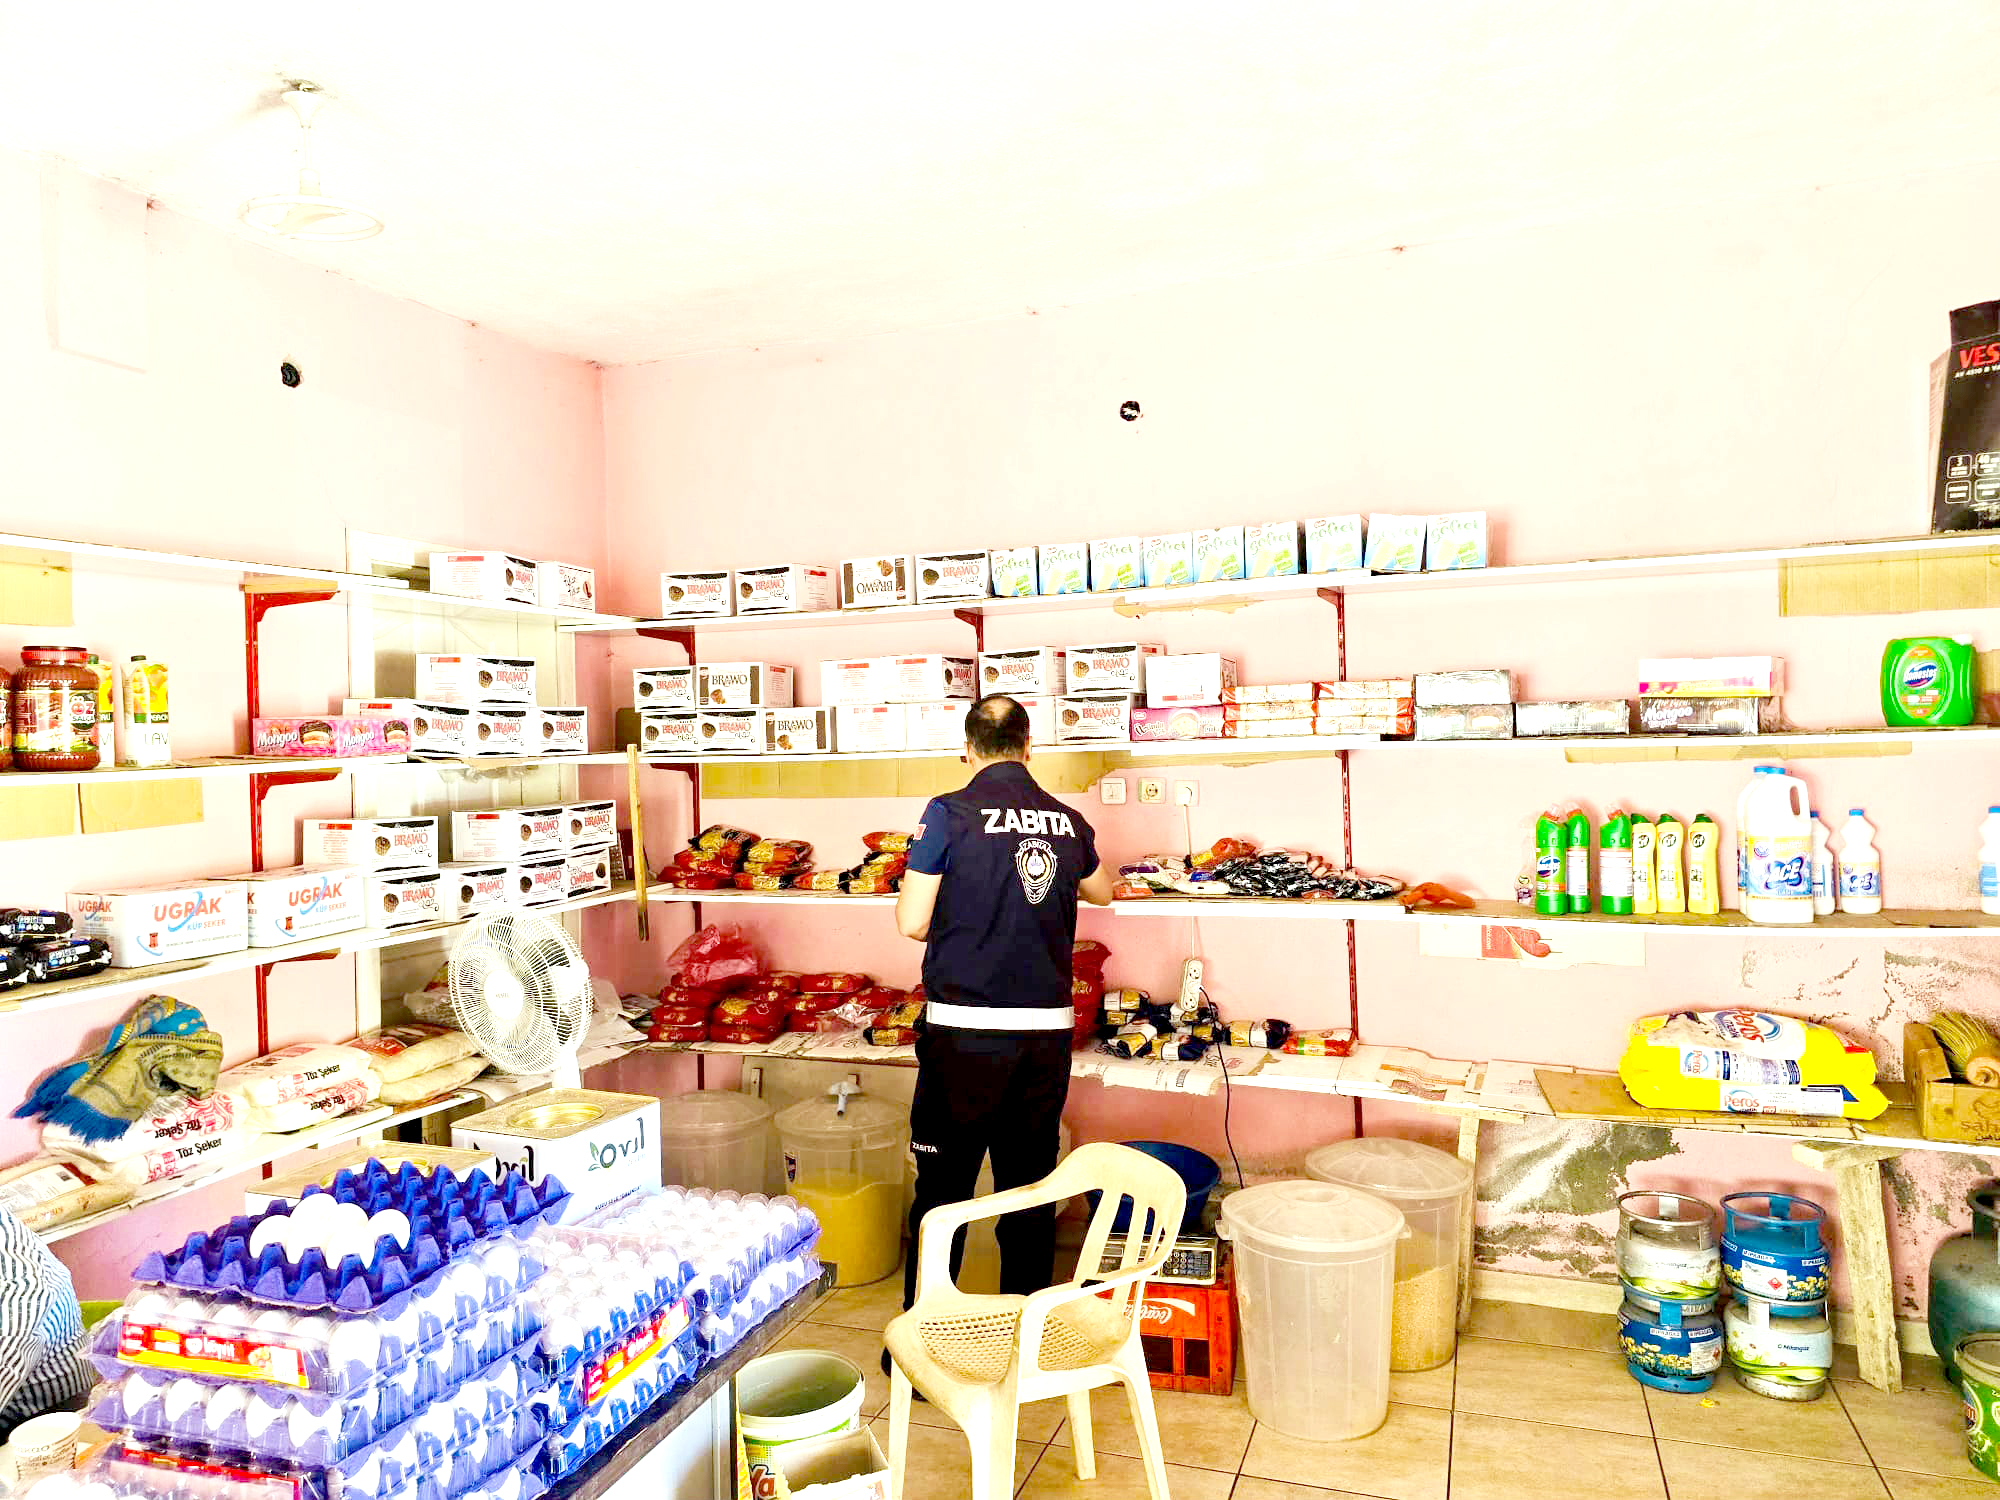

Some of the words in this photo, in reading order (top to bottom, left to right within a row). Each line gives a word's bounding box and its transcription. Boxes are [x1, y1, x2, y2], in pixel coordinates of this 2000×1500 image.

[943, 564, 979, 578] BRAWO
[687, 583, 722, 597] BRAWO
[755, 578, 785, 592] BRAWO
[1001, 662, 1034, 675] BRAWO
[1092, 658, 1130, 671] BRAWO
[496, 671, 528, 684] BRAWO
[711, 675, 748, 688] BRAWO
[656, 679, 687, 692] BRAWO
[1082, 707, 1120, 721] BRAWO
[1642, 706, 1693, 723] Mongoo
[432, 718, 463, 733] BRAWO
[494, 722, 521, 735] BRAWO
[556, 721, 580, 734] BRAWO
[662, 724, 694, 737] BRAWO
[719, 721, 751, 735] BRAWO
[777, 719, 814, 732] BRAWO
[257, 731, 297, 748] Mongoo
[343, 731, 374, 748] Mongoo
[534, 820, 559, 834] BRAWO
[585, 814, 610, 828] BRAWO
[980, 808, 1076, 838] ZABITA
[394, 833, 428, 848] BRAWO
[1021, 840, 1050, 851] ZABITA
[535, 870, 561, 885] BRAWO
[1767, 861, 1802, 883] ACE
[477, 880, 504, 894] BRAWO
[1851, 876, 1872, 889] ACE
[402, 887, 435, 903] BRAWO
[1724, 1094, 1760, 1107] Peros
[194, 1138, 222, 1155] Şeker
